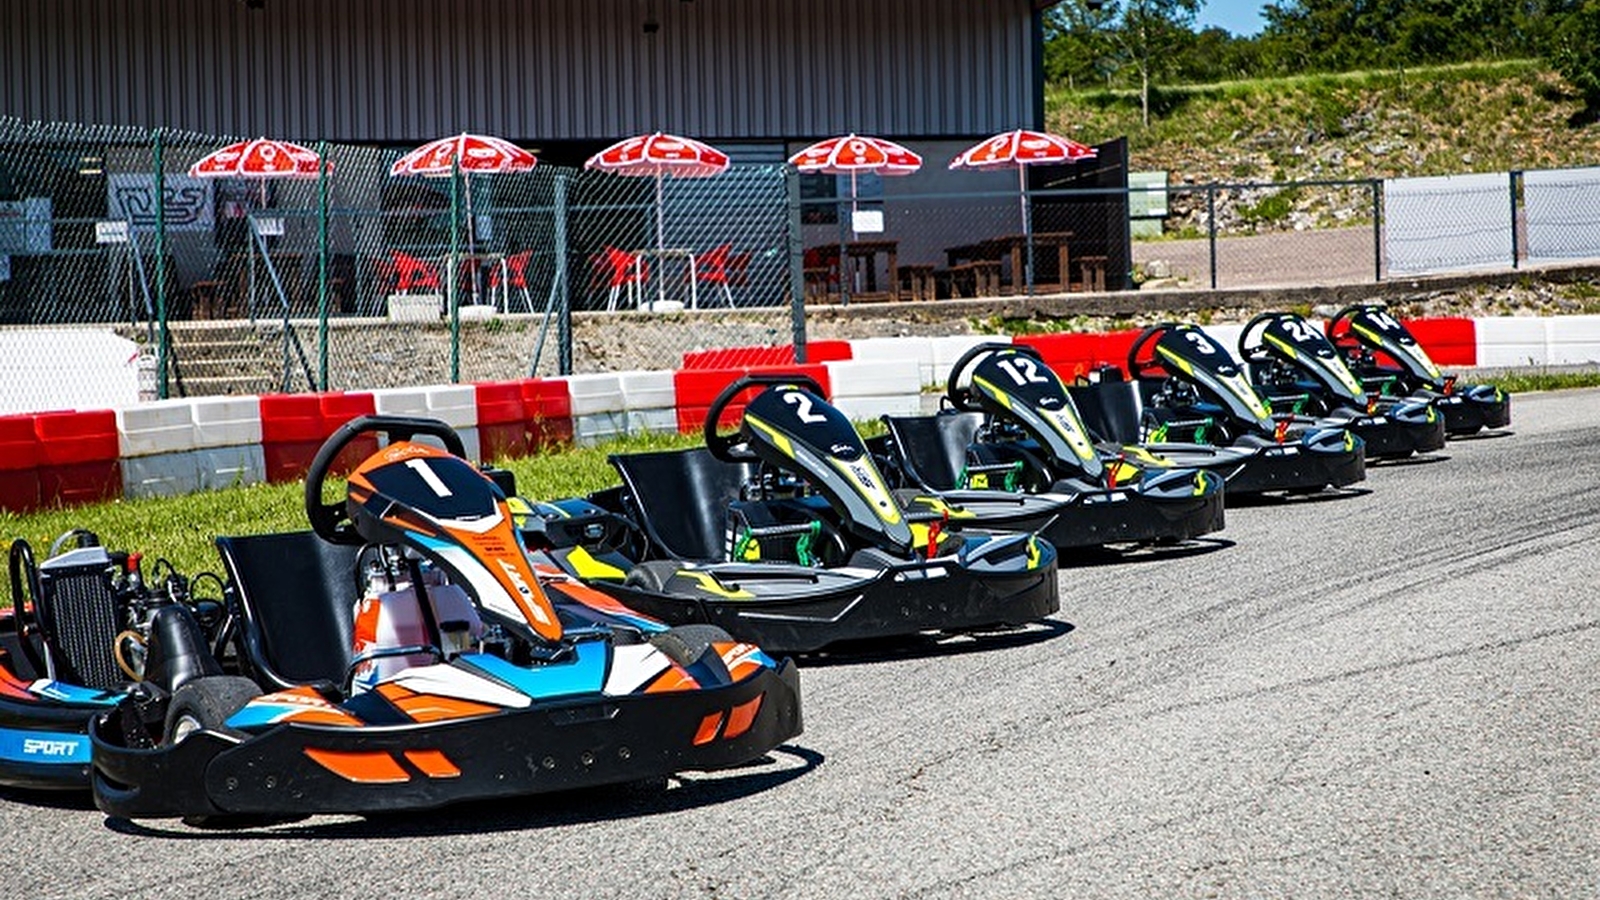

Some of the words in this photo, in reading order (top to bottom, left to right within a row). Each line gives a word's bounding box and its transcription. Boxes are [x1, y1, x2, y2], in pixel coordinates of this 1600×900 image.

[1282, 320, 1322, 341] 24
[1367, 312, 1398, 330] 14
[1185, 332, 1216, 354] 3
[996, 358, 1049, 386] 12
[782, 392, 828, 424] 2
[404, 458, 453, 498] 1
[23, 739, 79, 756] SPORT
